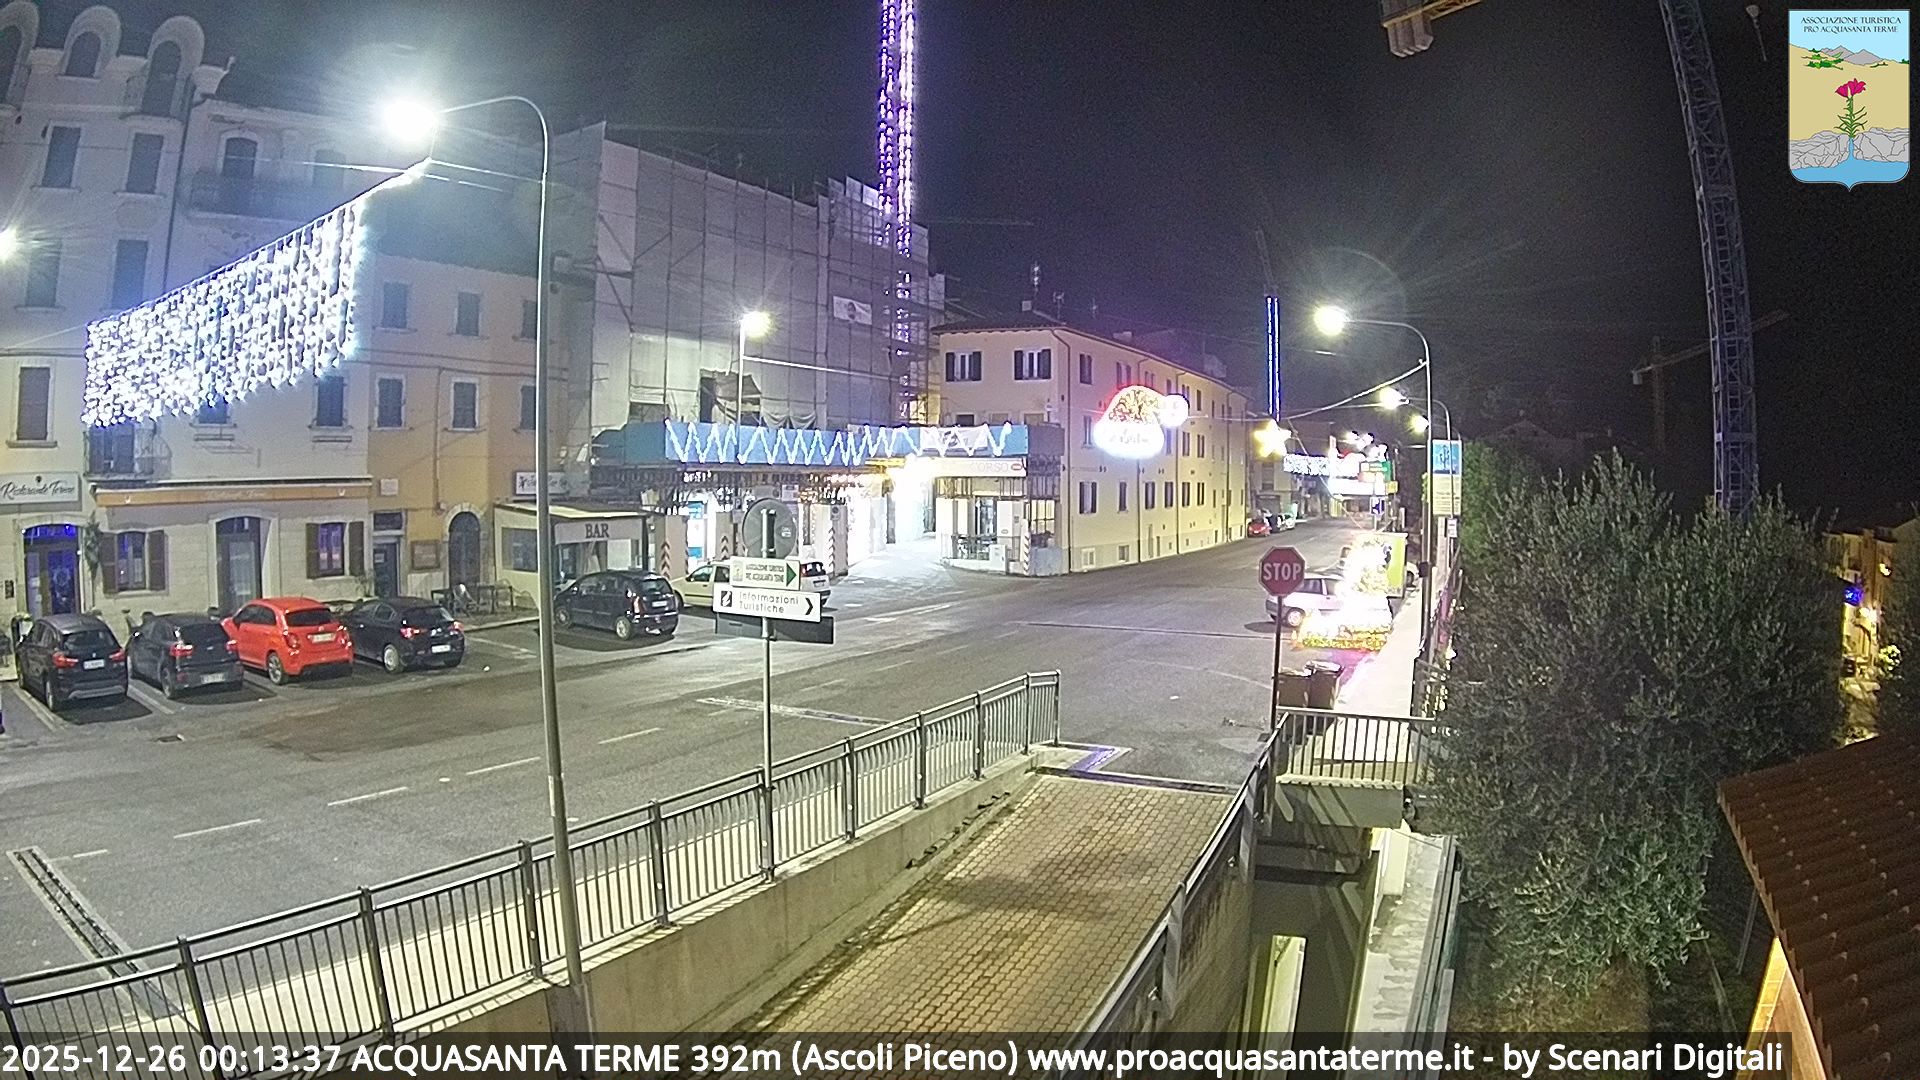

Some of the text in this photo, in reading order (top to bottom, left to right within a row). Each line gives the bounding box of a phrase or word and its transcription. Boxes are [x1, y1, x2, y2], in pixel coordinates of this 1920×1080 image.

[585, 523, 610, 539] BAR
[1263, 562, 1302, 581] STOP
[739, 591, 799, 605] Informazioni
[739, 601, 785, 614] Turistiche
